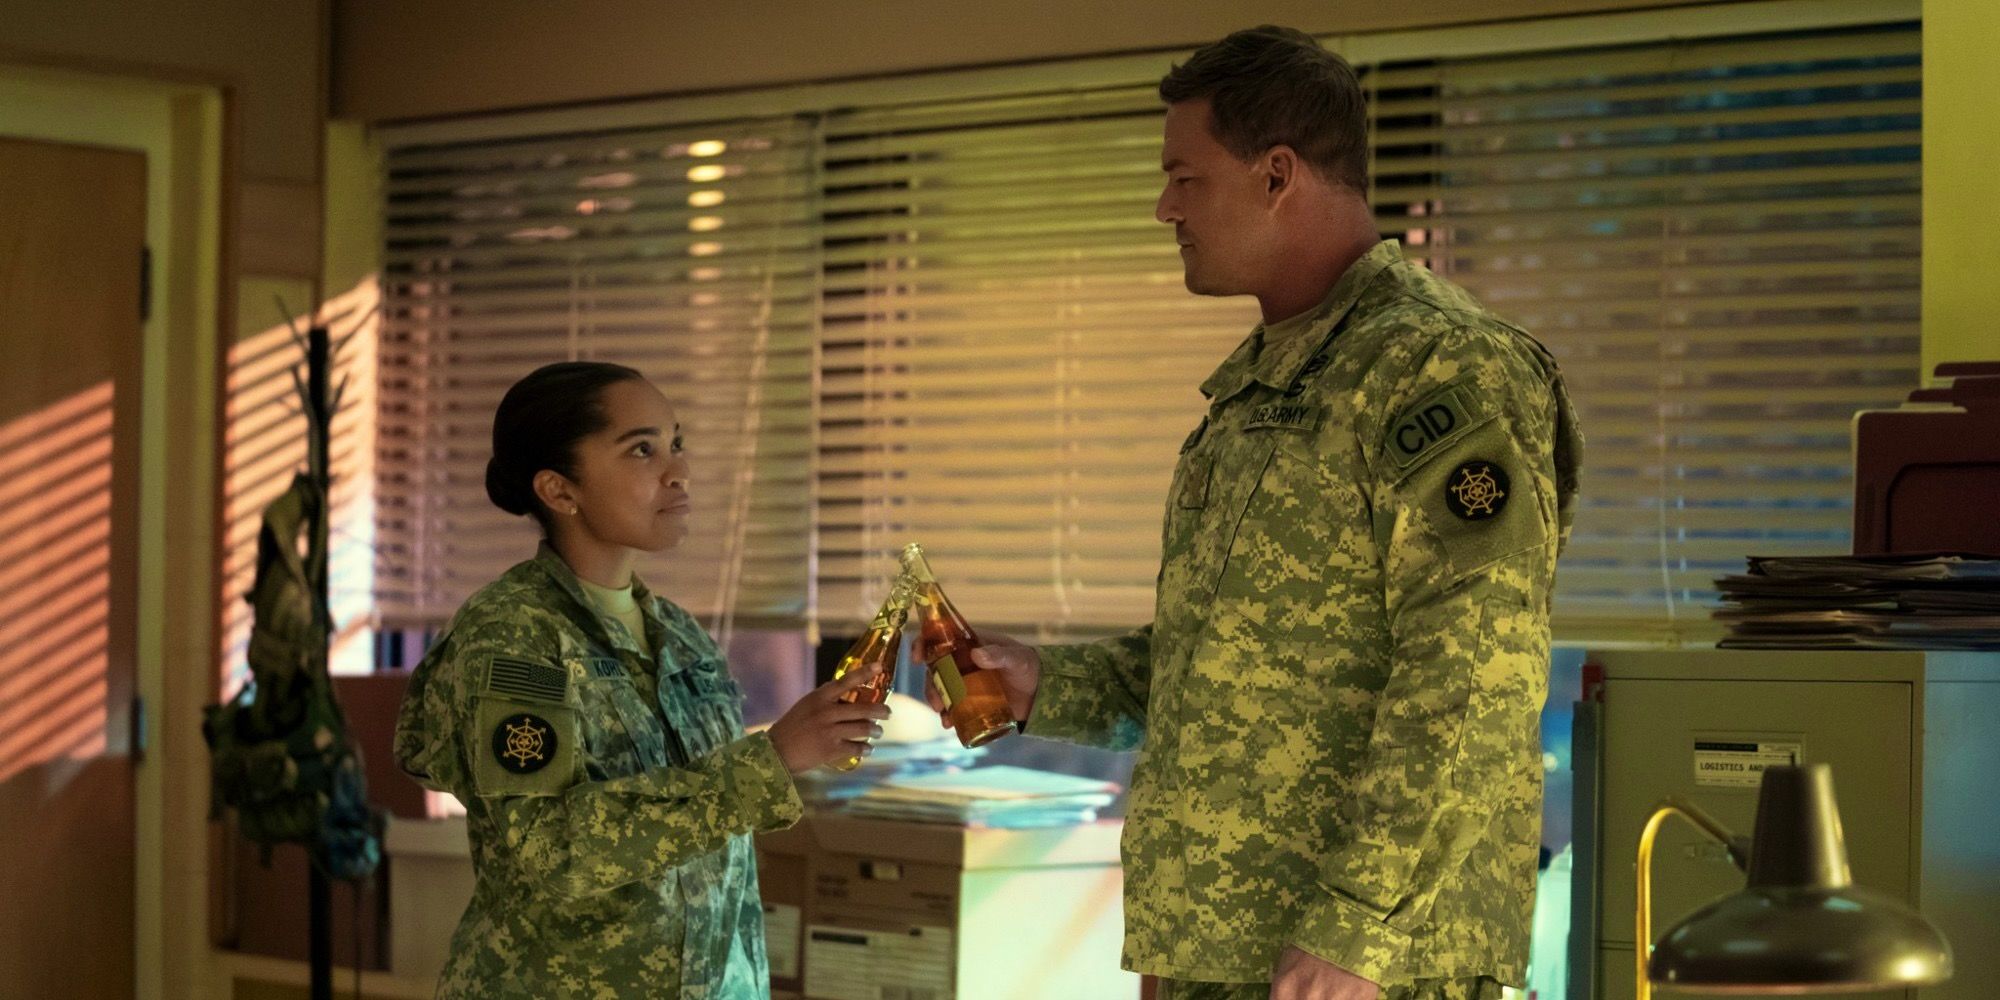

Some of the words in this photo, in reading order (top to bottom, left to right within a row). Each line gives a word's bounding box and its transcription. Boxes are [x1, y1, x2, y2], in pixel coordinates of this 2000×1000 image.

[1266, 406, 1310, 424] ARMY
[1396, 404, 1455, 454] CID
[1700, 762, 1744, 771] LOGISTICS
